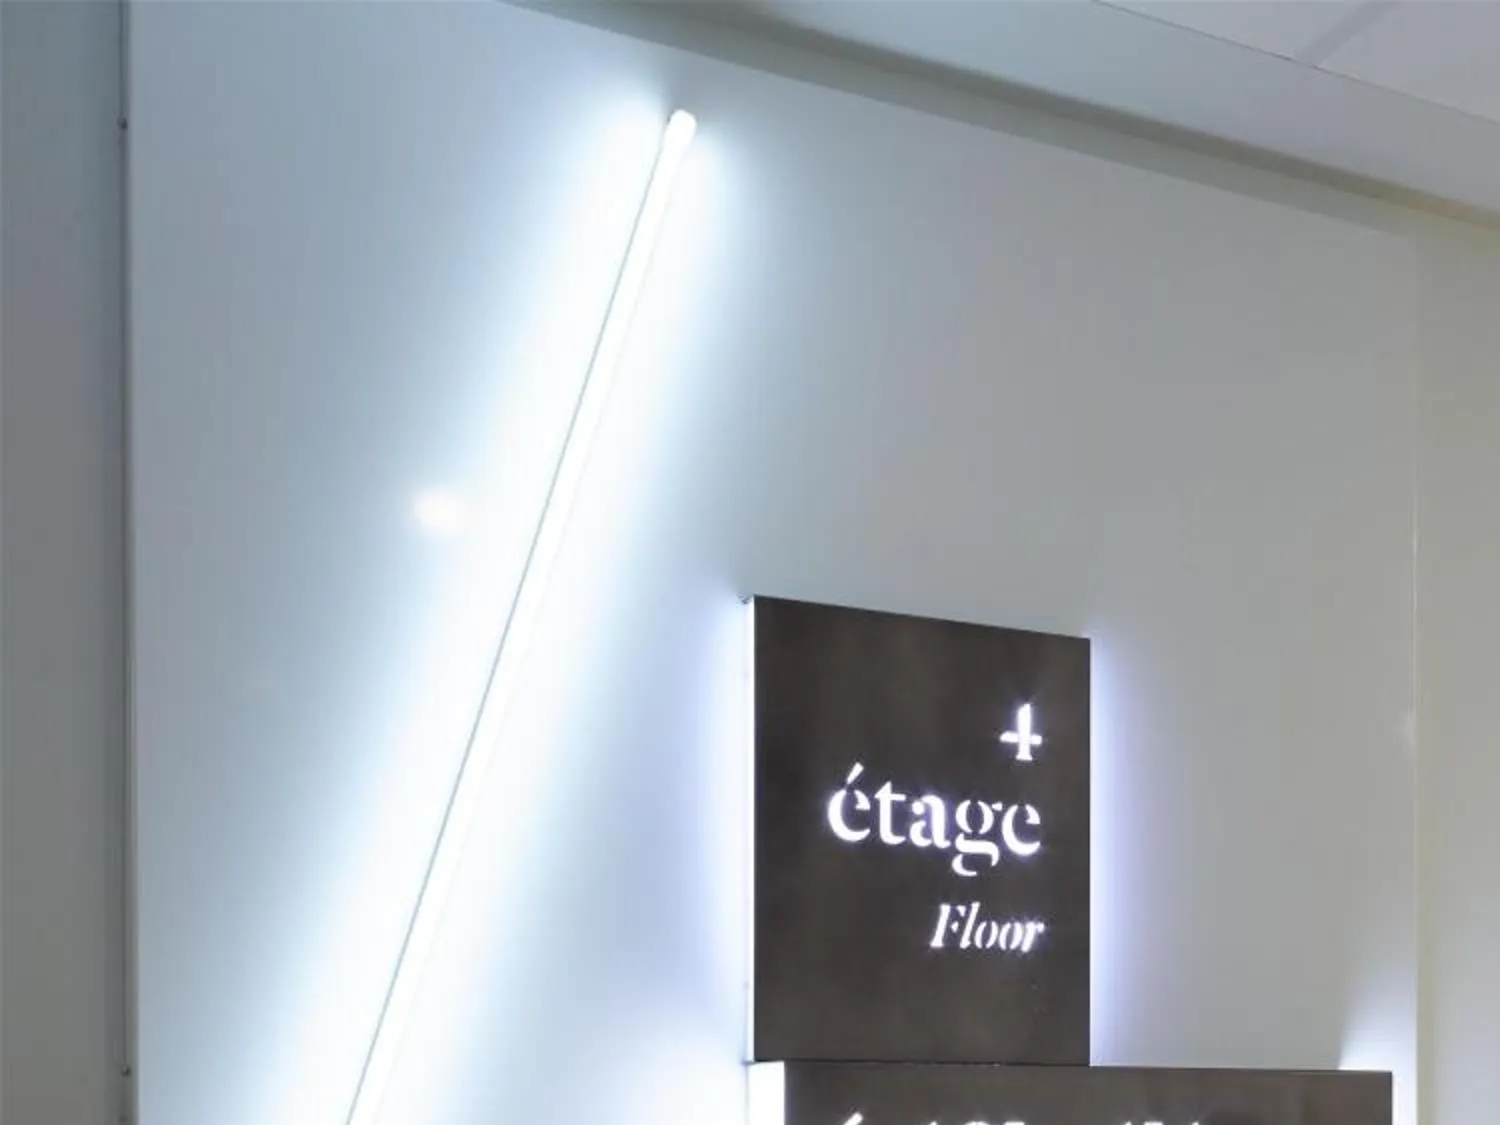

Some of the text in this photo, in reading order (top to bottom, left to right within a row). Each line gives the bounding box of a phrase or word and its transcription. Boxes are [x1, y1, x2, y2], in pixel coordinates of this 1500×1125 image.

[998, 702, 1044, 762] 4
[826, 762, 1041, 877] étage
[928, 901, 1046, 953] Floor
